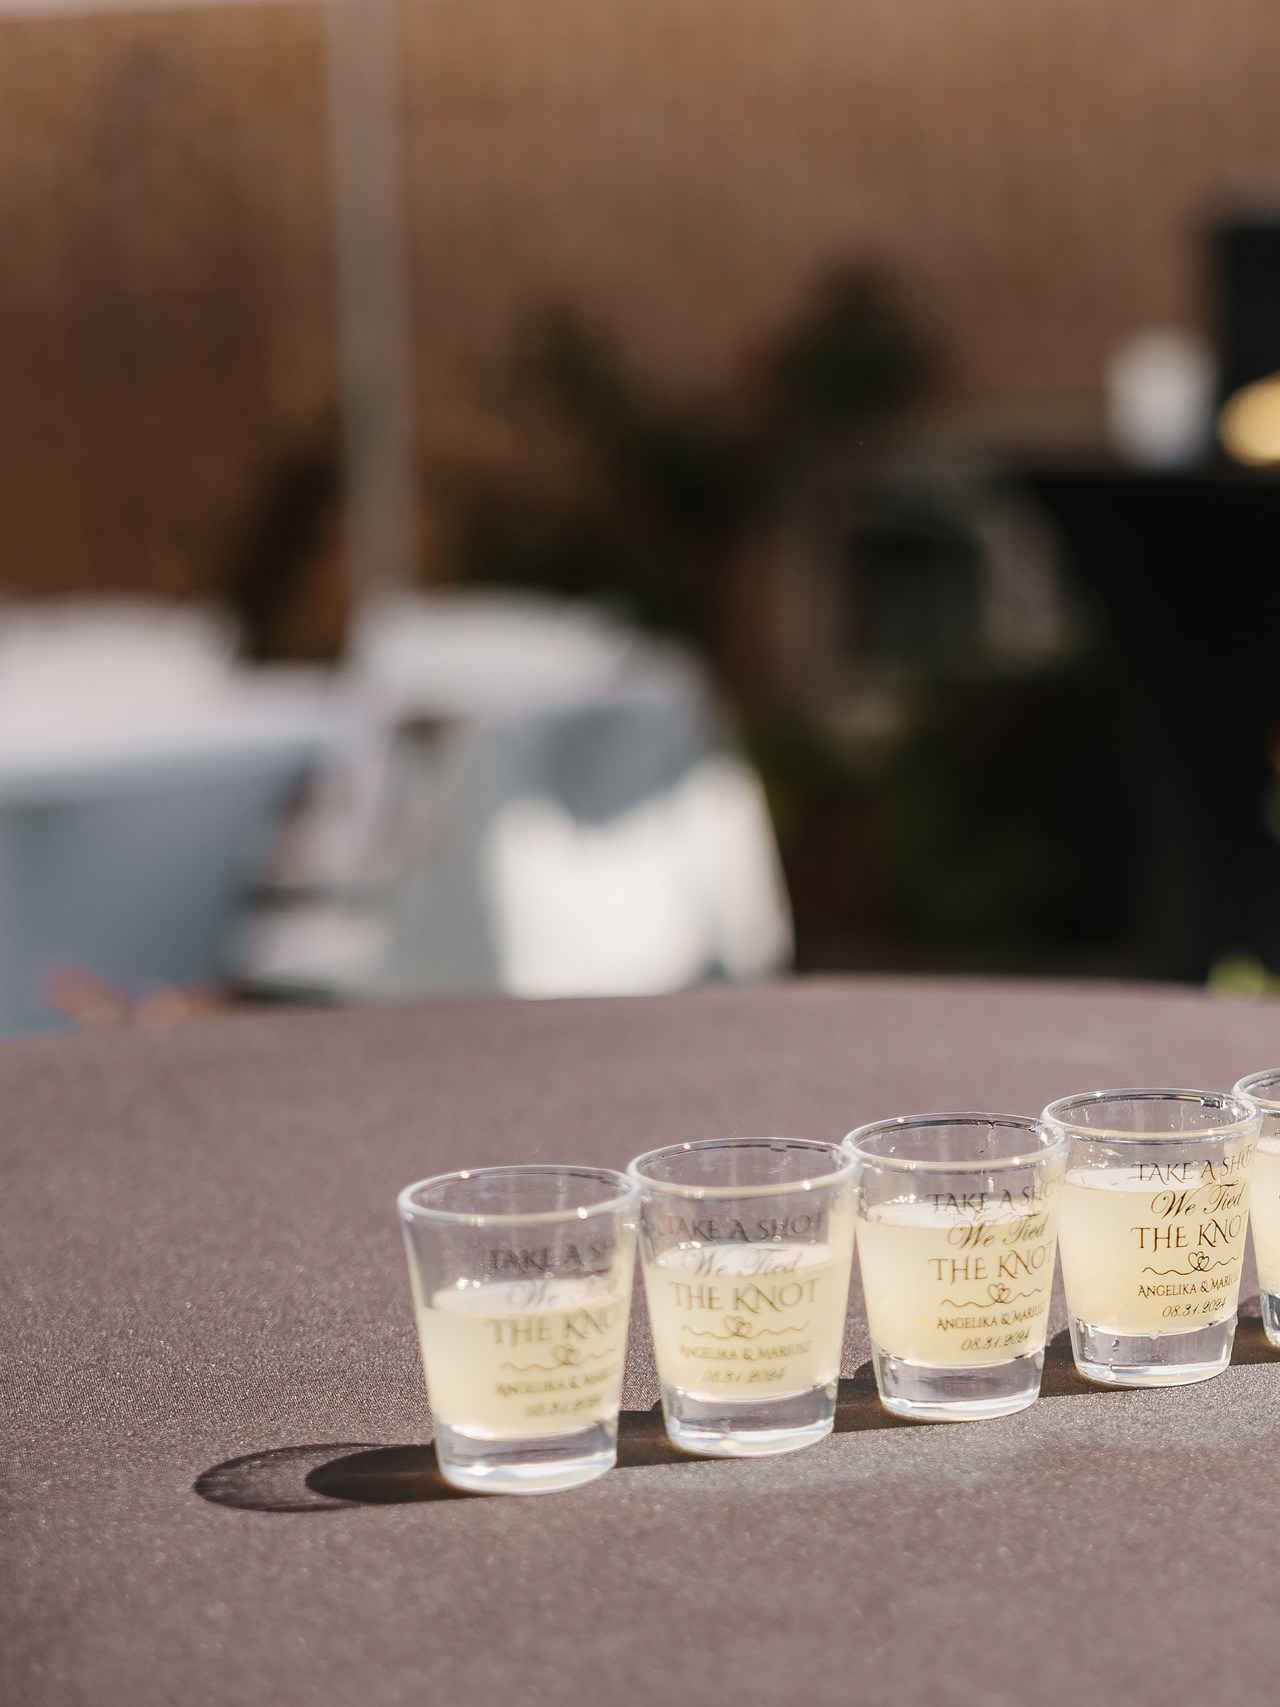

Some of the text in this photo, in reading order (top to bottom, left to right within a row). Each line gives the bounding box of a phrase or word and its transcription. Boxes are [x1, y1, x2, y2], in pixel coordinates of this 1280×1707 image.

[1131, 1162, 1194, 1185] TAKE
[1200, 1159, 1216, 1180] A
[927, 1178, 1056, 1217] TAKE A SHO
[1151, 1180, 1246, 1220] We Tied
[663, 1211, 826, 1242] TAKE A SHOT
[948, 1211, 1049, 1250] We Tied
[1130, 1210, 1247, 1253] THE KNOT
[927, 1255, 988, 1284] THE
[668, 1277, 821, 1315] THE KNOT
[1138, 1284, 1197, 1300] ANGELIKA
[1200, 1280, 1210, 1293] &
[1162, 1294, 1229, 1318] 08.31.2024
[486, 1302, 621, 1347] THE KNO
[936, 1316, 998, 1332] ANGELIKA
[1001, 1313, 1011, 1326] &
[961, 1327, 1032, 1351] 08.31.2024
